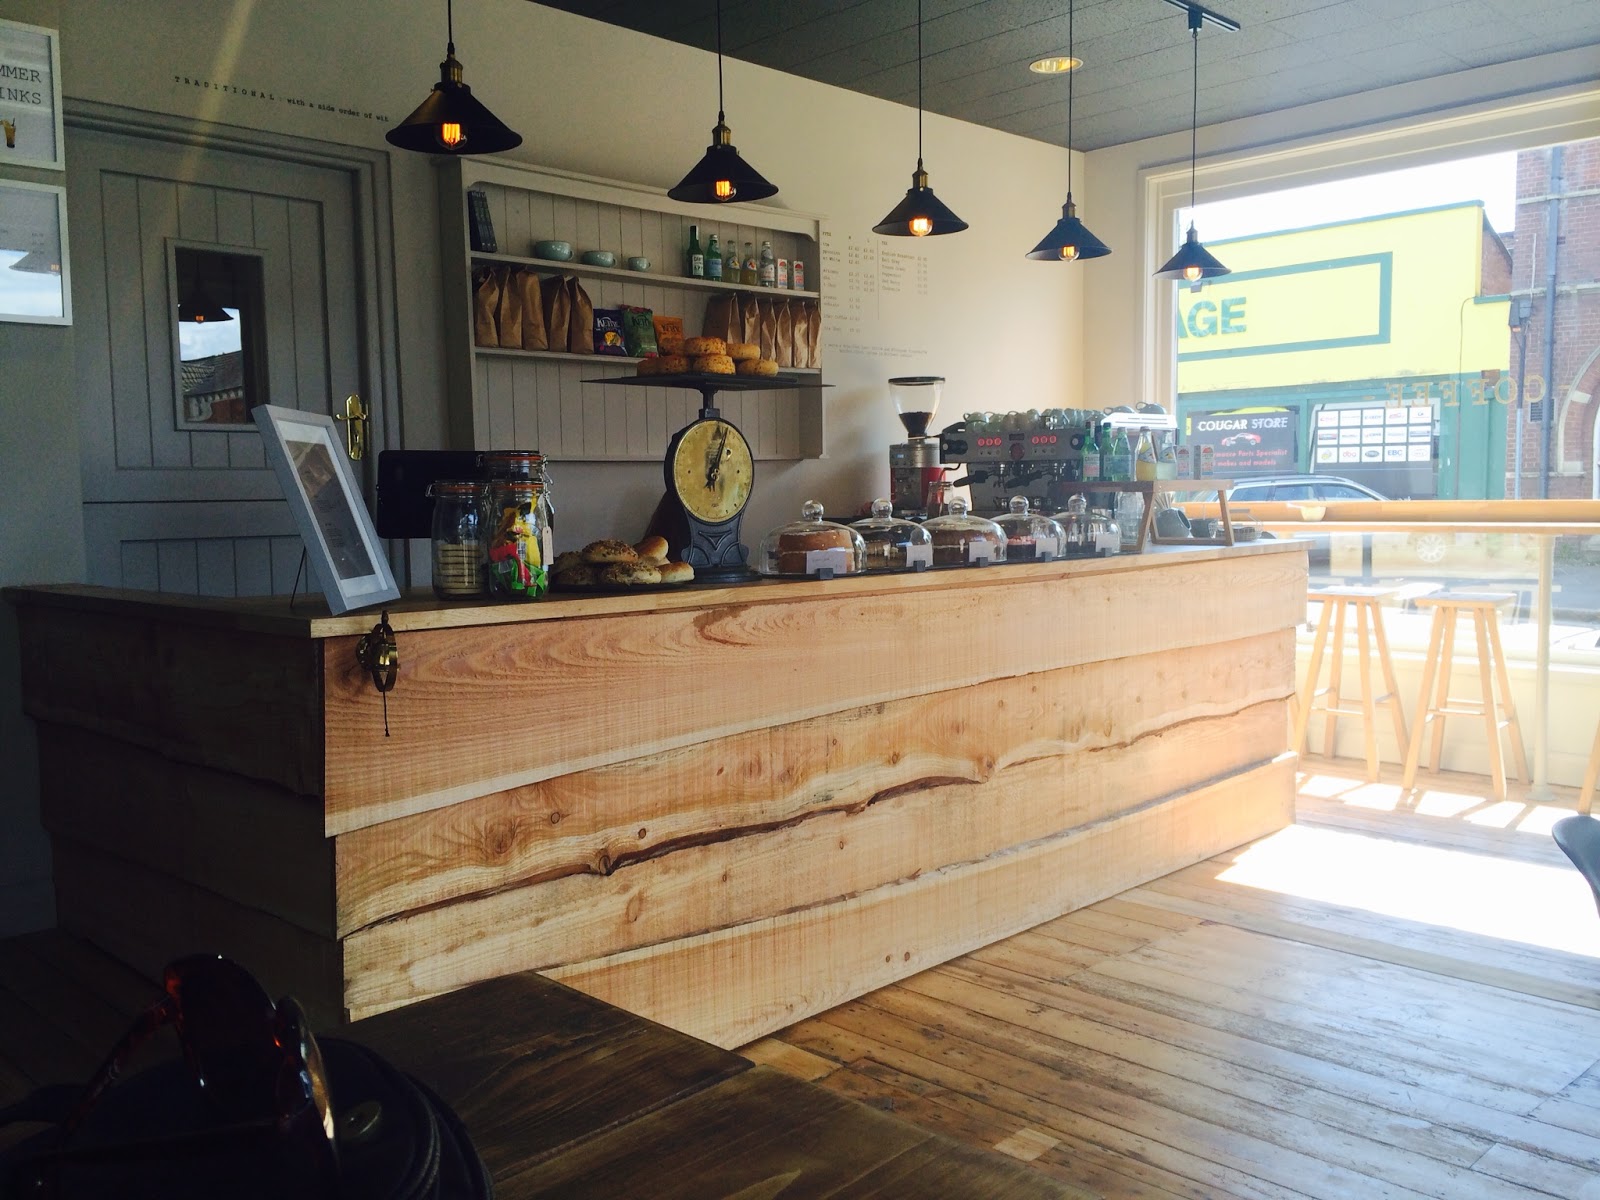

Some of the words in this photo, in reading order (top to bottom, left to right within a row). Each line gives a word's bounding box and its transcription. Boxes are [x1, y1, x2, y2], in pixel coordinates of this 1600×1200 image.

[286, 97, 305, 106] with
[317, 104, 335, 112] side
[338, 108, 360, 117] order
[1198, 419, 1248, 431] COUGAR
[1251, 417, 1288, 429] STORE
[1256, 449, 1288, 458] Specialist
